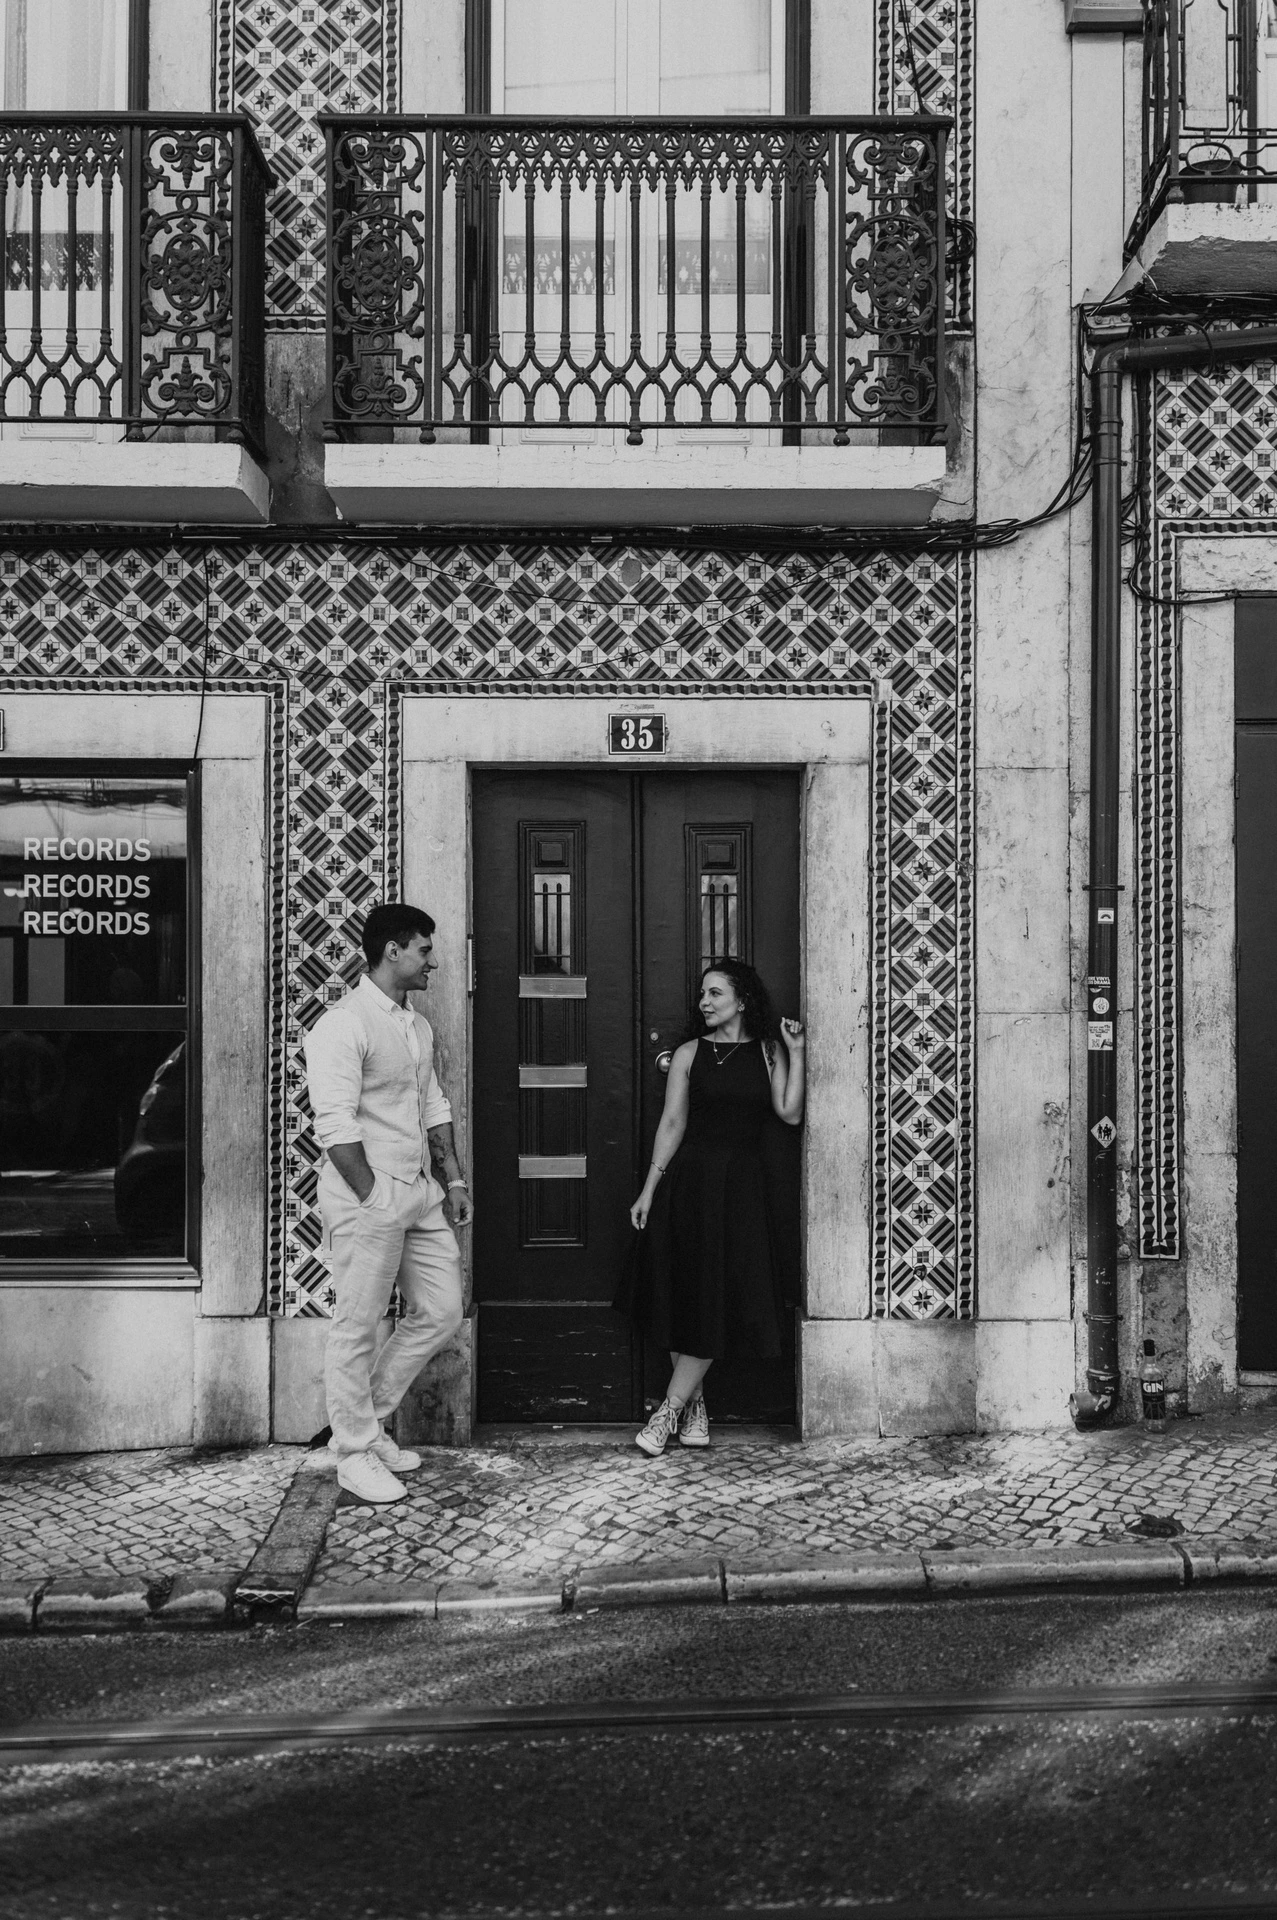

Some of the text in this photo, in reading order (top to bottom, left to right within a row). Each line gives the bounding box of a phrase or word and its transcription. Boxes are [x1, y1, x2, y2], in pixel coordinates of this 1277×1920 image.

[620, 718, 654, 750] 35
[23, 837, 152, 862] RECORDS
[23, 874, 151, 899] RECORDS
[23, 911, 151, 936] RECORDS
[1142, 1381, 1164, 1393] GIN
